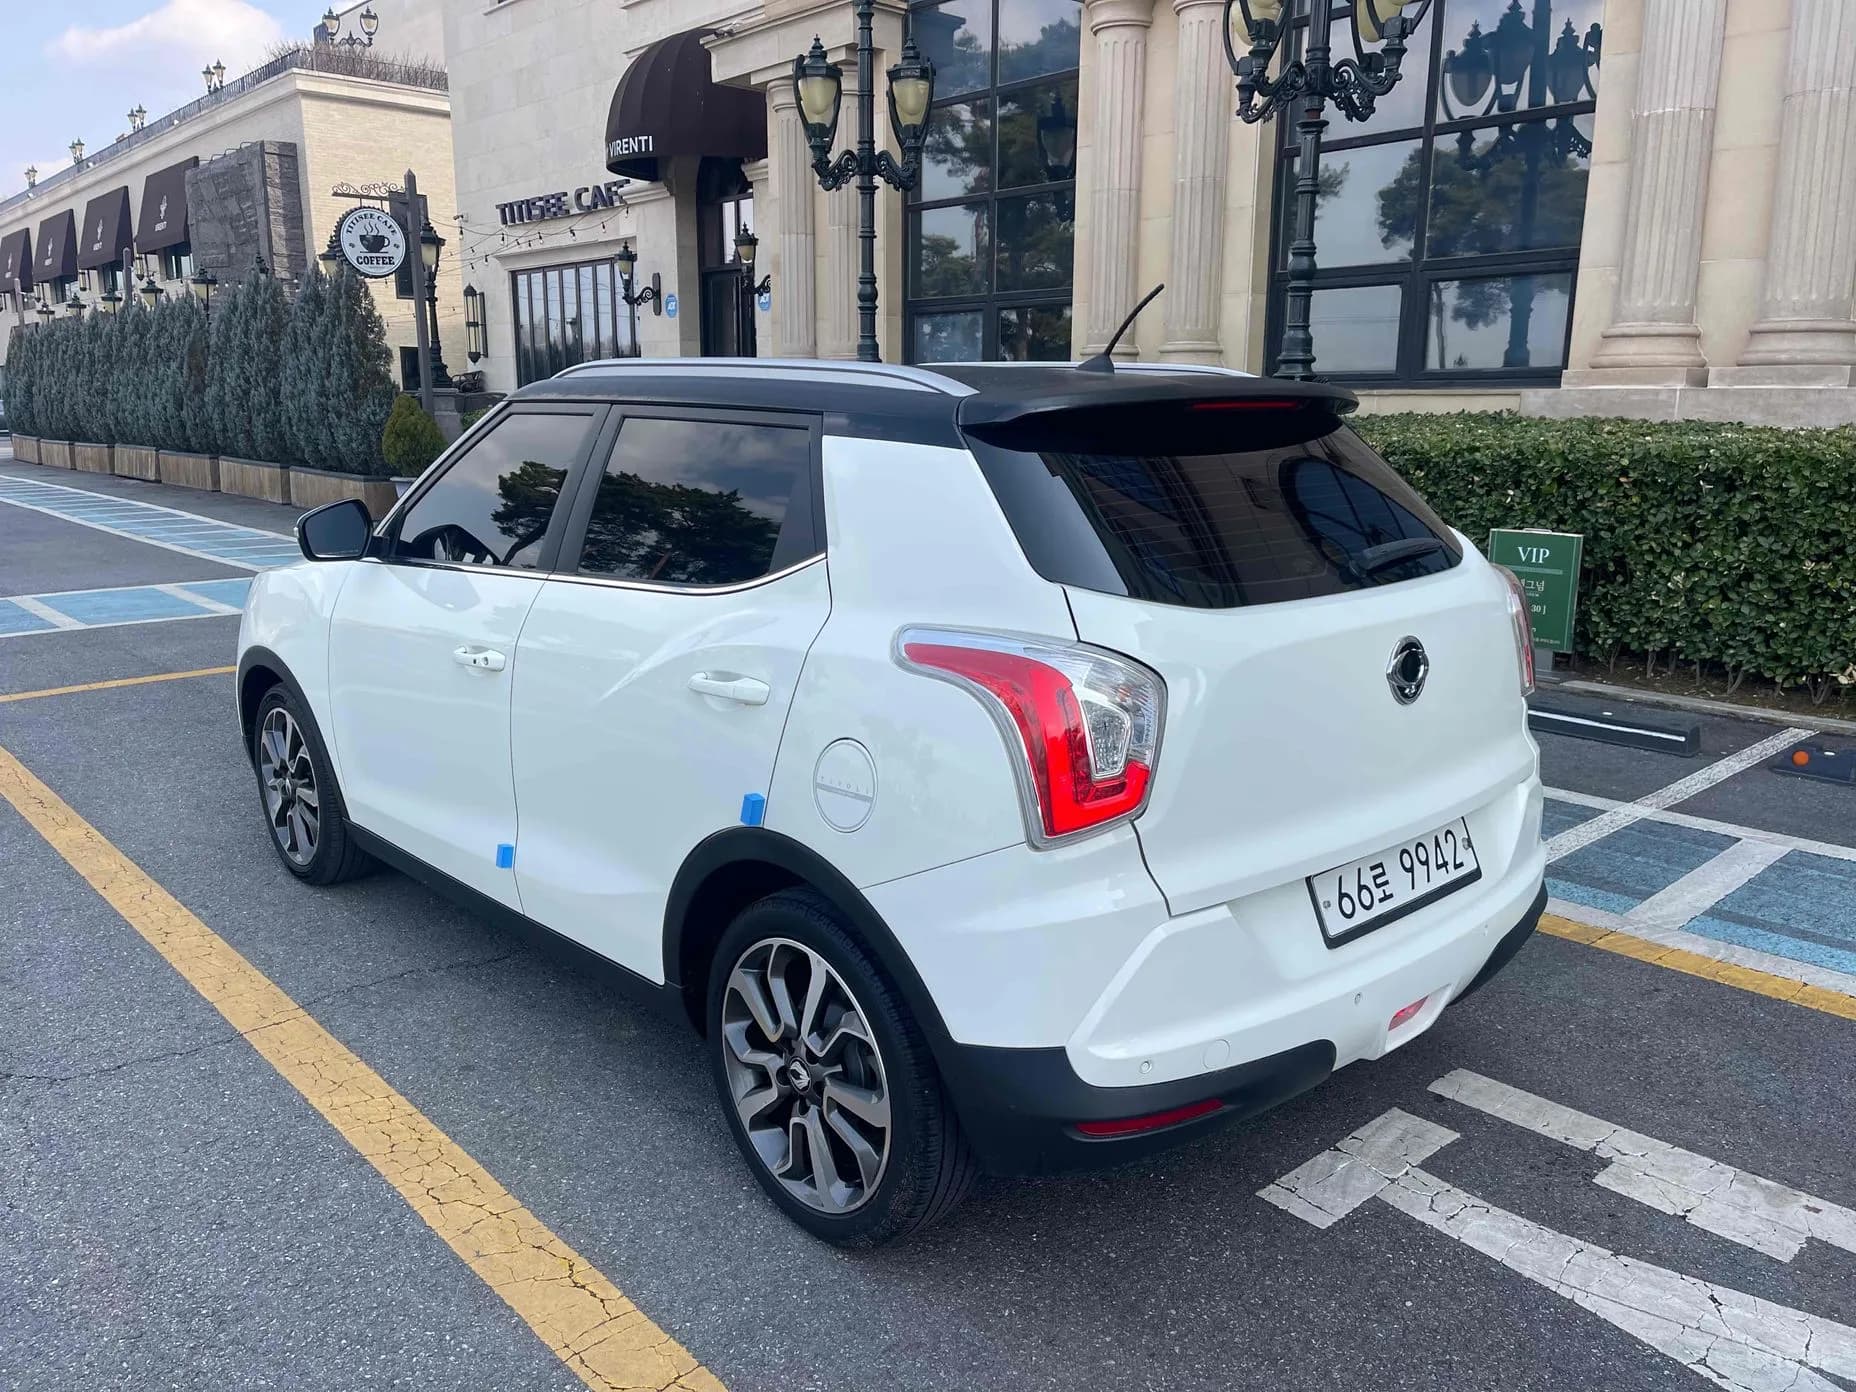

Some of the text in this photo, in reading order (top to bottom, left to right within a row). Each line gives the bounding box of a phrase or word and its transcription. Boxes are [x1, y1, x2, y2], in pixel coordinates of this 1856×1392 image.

[496, 191, 570, 225] TITISEE
[346, 213, 398, 236] TITISEE CAFE
[356, 255, 395, 266] COFFEE
[1518, 546, 1550, 563] VIP
[1338, 829, 1464, 919] 66로 9942
